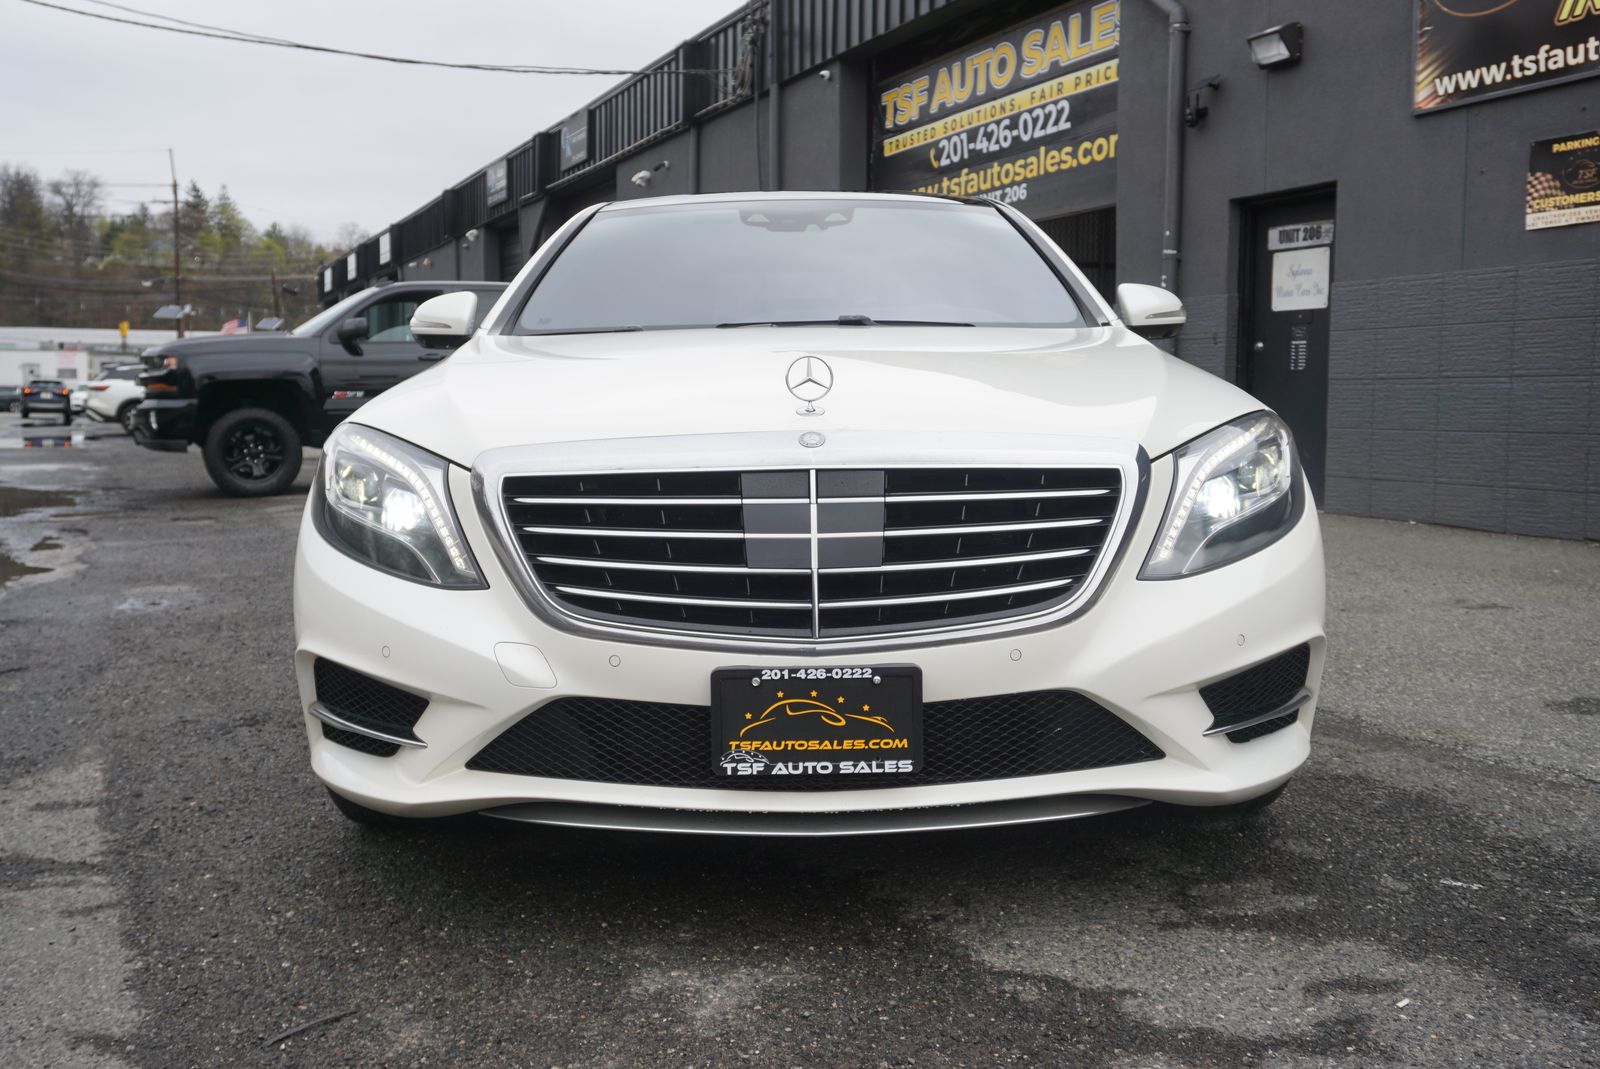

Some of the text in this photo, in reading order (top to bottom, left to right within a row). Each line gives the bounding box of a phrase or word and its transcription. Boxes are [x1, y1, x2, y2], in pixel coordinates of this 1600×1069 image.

[882, 0, 1120, 129] TSF AUTO SALE
[1435, 36, 1600, 96] www.tsfaut
[888, 127, 937, 153] TRUSTED
[1030, 81, 1064, 105] FAIR
[938, 100, 1071, 167] 201-426-0222
[1551, 136, 1600, 153] PARKING
[1003, 183, 1028, 203] 206
[1533, 191, 1600, 209] CUSTOMERS
[1279, 228, 1301, 244] UNIT
[1302, 225, 1322, 241] 206
[761, 668, 873, 680] 201-426-0222
[729, 738, 909, 751] TSFAUTOSALES.COM
[723, 760, 914, 775] TSF AUTO SALES
